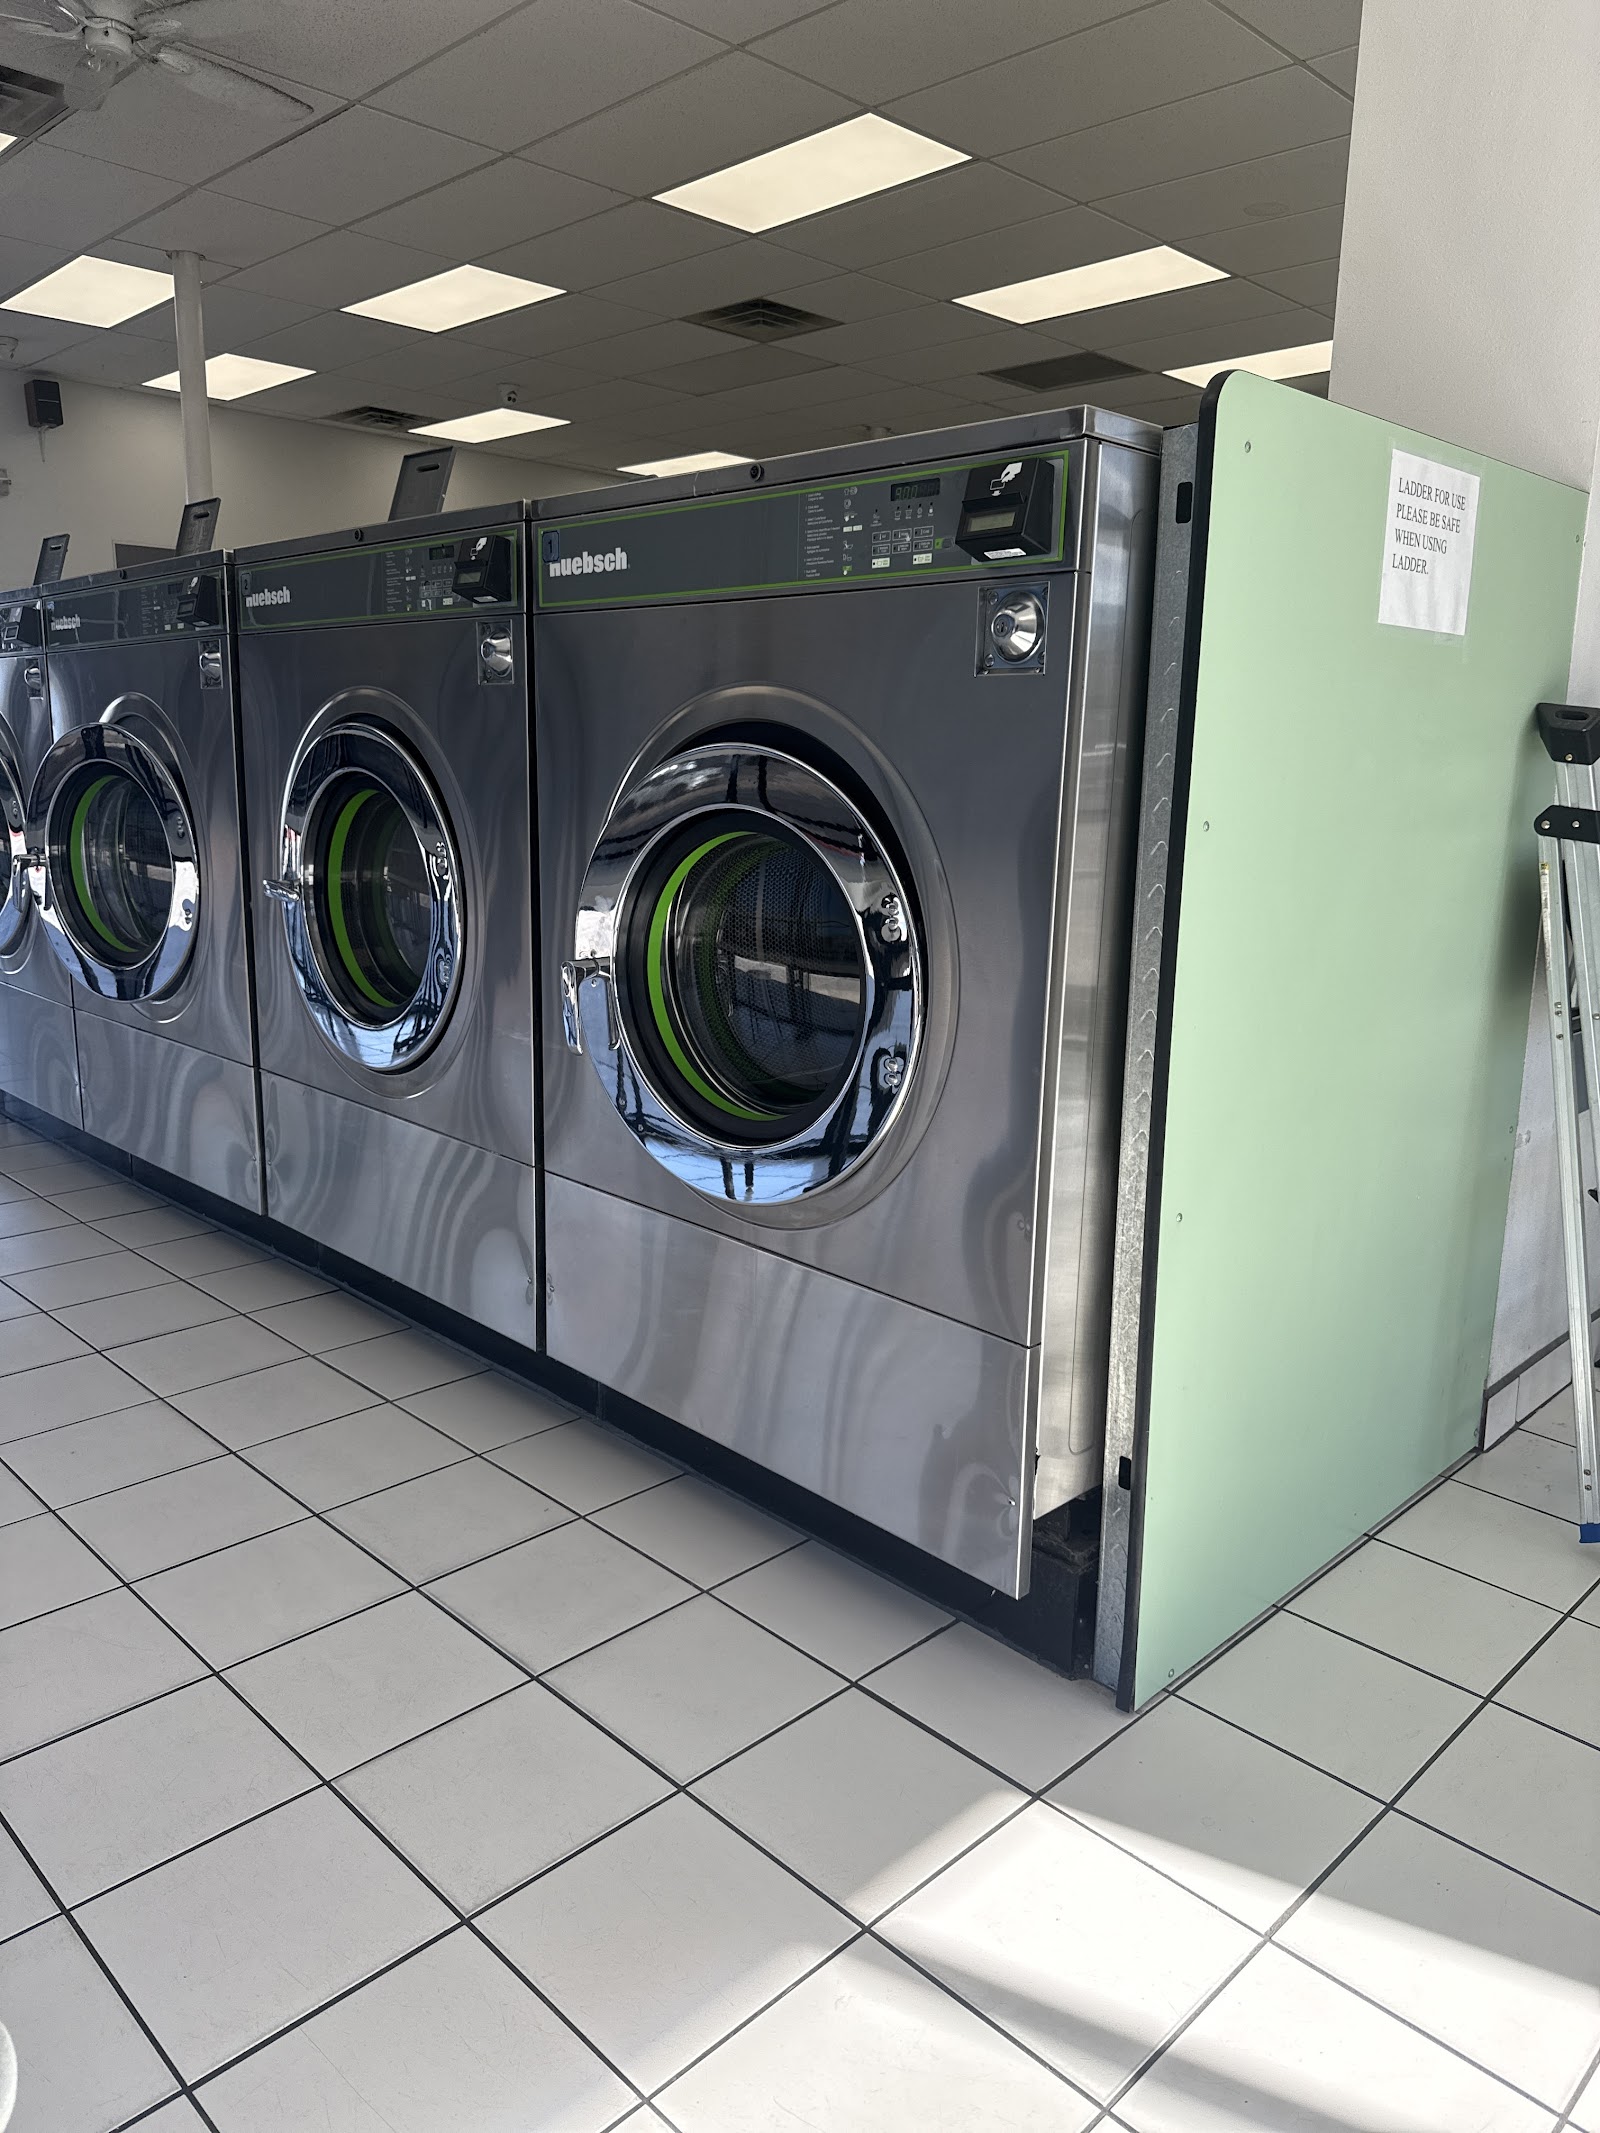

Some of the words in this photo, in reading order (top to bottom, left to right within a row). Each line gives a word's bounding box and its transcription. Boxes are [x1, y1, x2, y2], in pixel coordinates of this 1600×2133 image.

[1398, 478, 1433, 502] LADDER
[1434, 487, 1450, 506] FOR
[1451, 493, 1466, 511] USE
[1396, 503, 1428, 525] PLEASE
[1429, 511, 1440, 528] BE
[1441, 515, 1461, 534] SAFE
[1395, 528, 1421, 548] WHEN
[1422, 534, 1447, 554] USING
[1392, 553, 1429, 575] LADDER.
